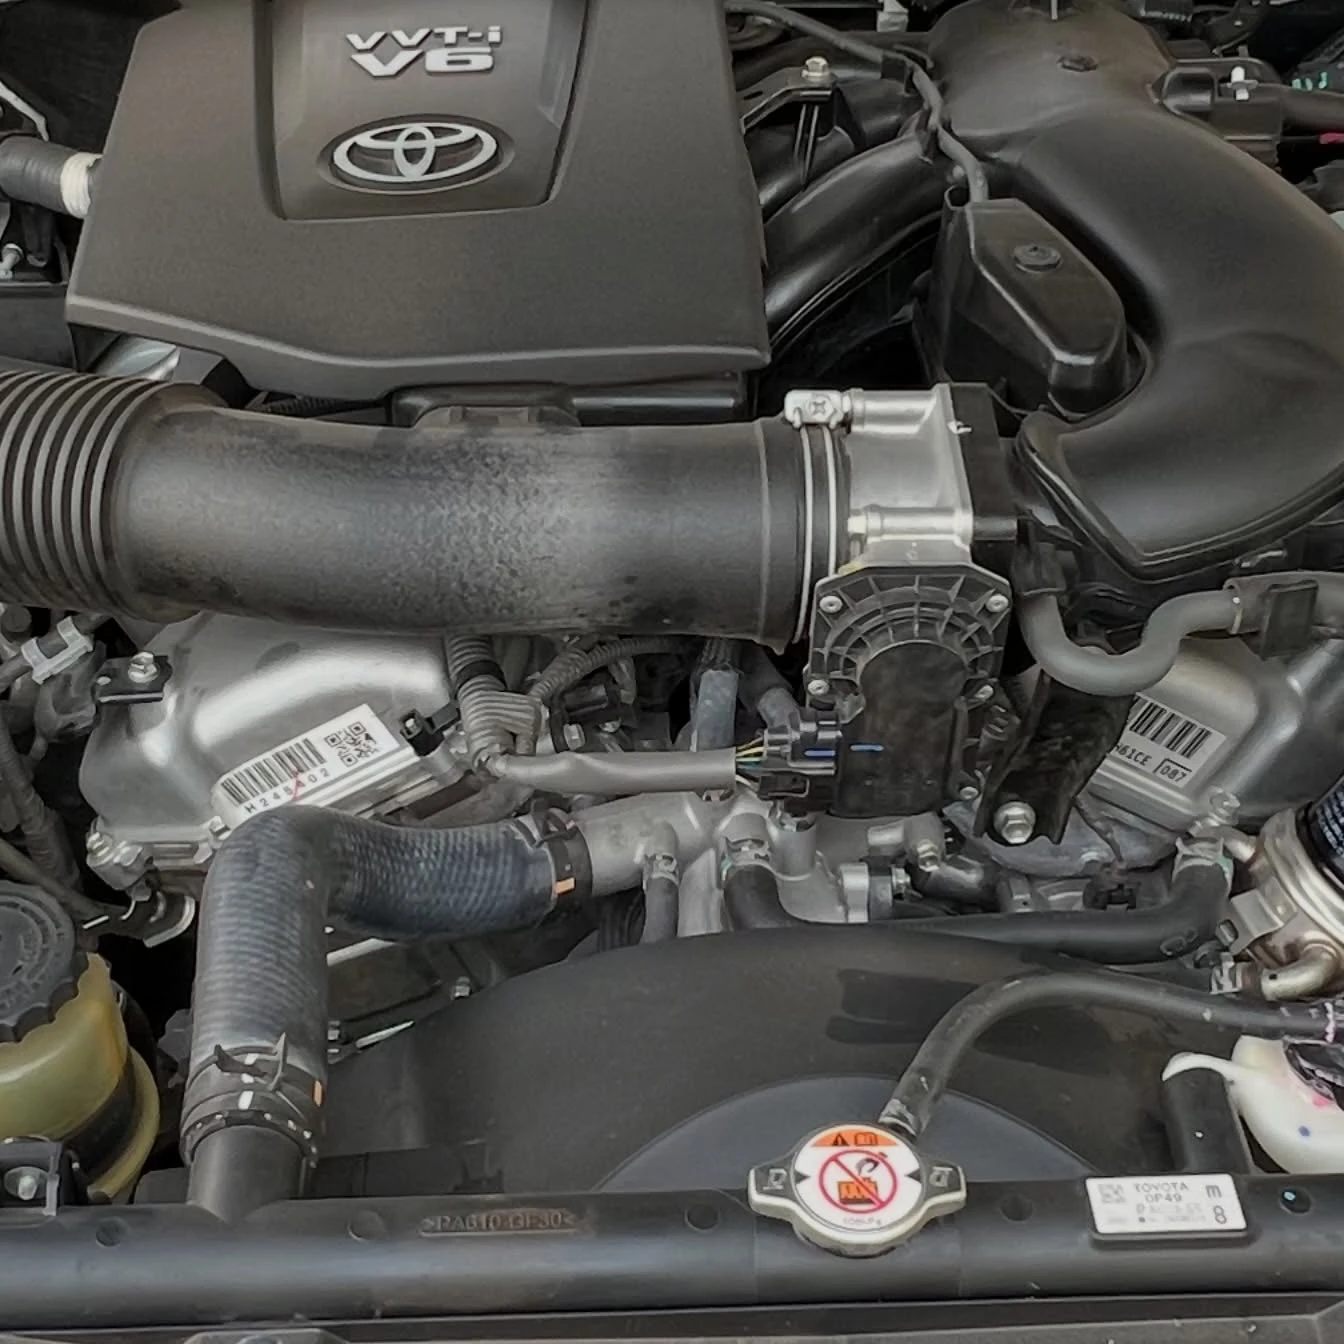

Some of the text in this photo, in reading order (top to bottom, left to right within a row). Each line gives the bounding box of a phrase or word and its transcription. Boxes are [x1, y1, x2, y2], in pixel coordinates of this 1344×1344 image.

[345, 25, 502, 52] VVT-i
[350, 47, 494, 78] V6
[1159, 764, 1187, 782] 087
